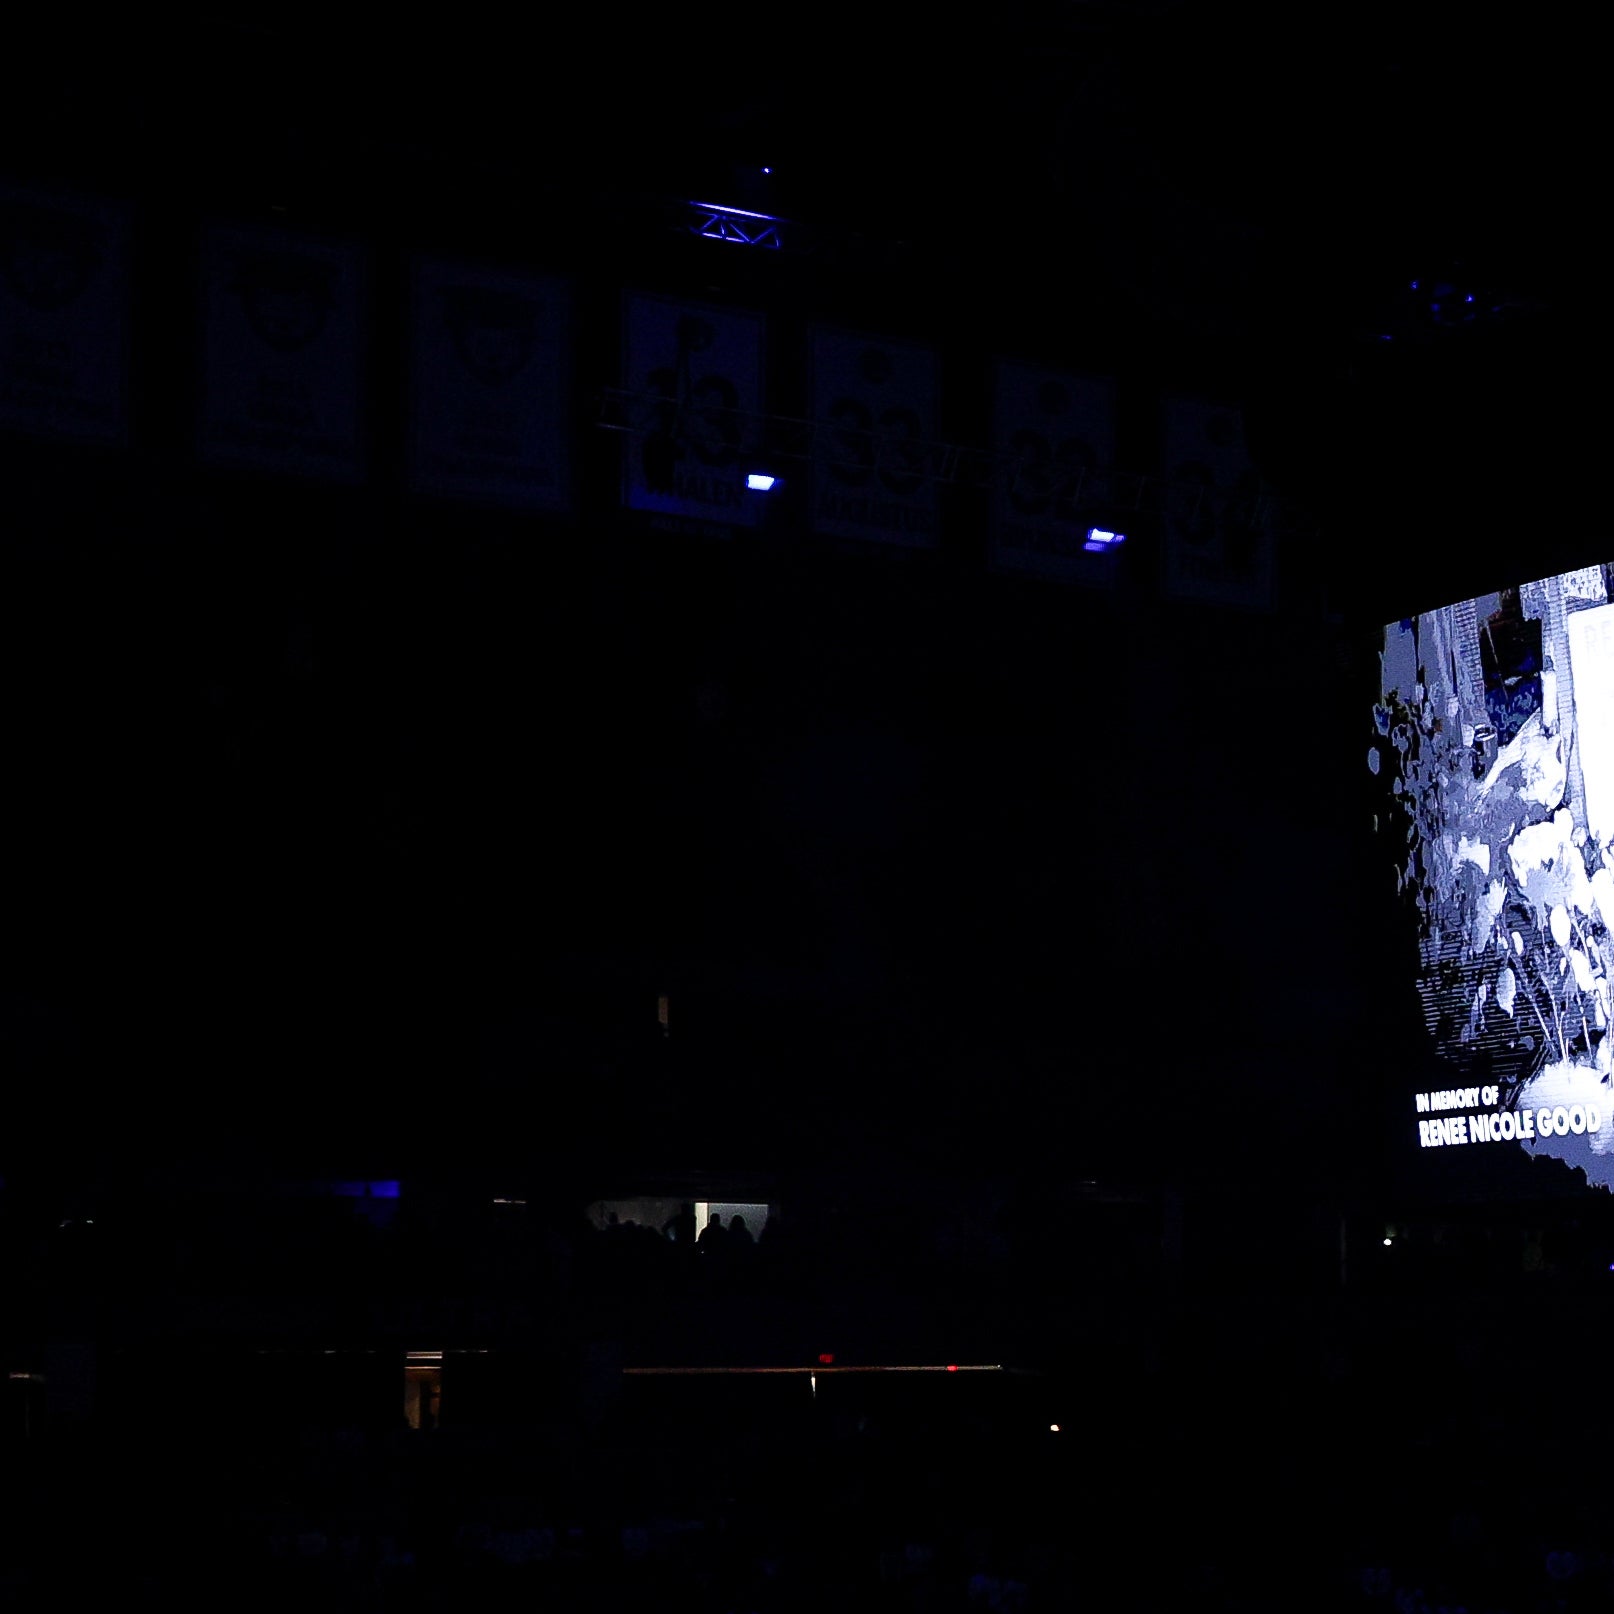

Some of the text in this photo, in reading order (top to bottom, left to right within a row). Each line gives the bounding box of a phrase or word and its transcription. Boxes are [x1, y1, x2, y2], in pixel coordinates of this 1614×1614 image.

[1415, 1085, 1500, 1112] IN MEMORY OF
[1418, 1103, 1601, 1147] RENEE NICOLE GOOD
